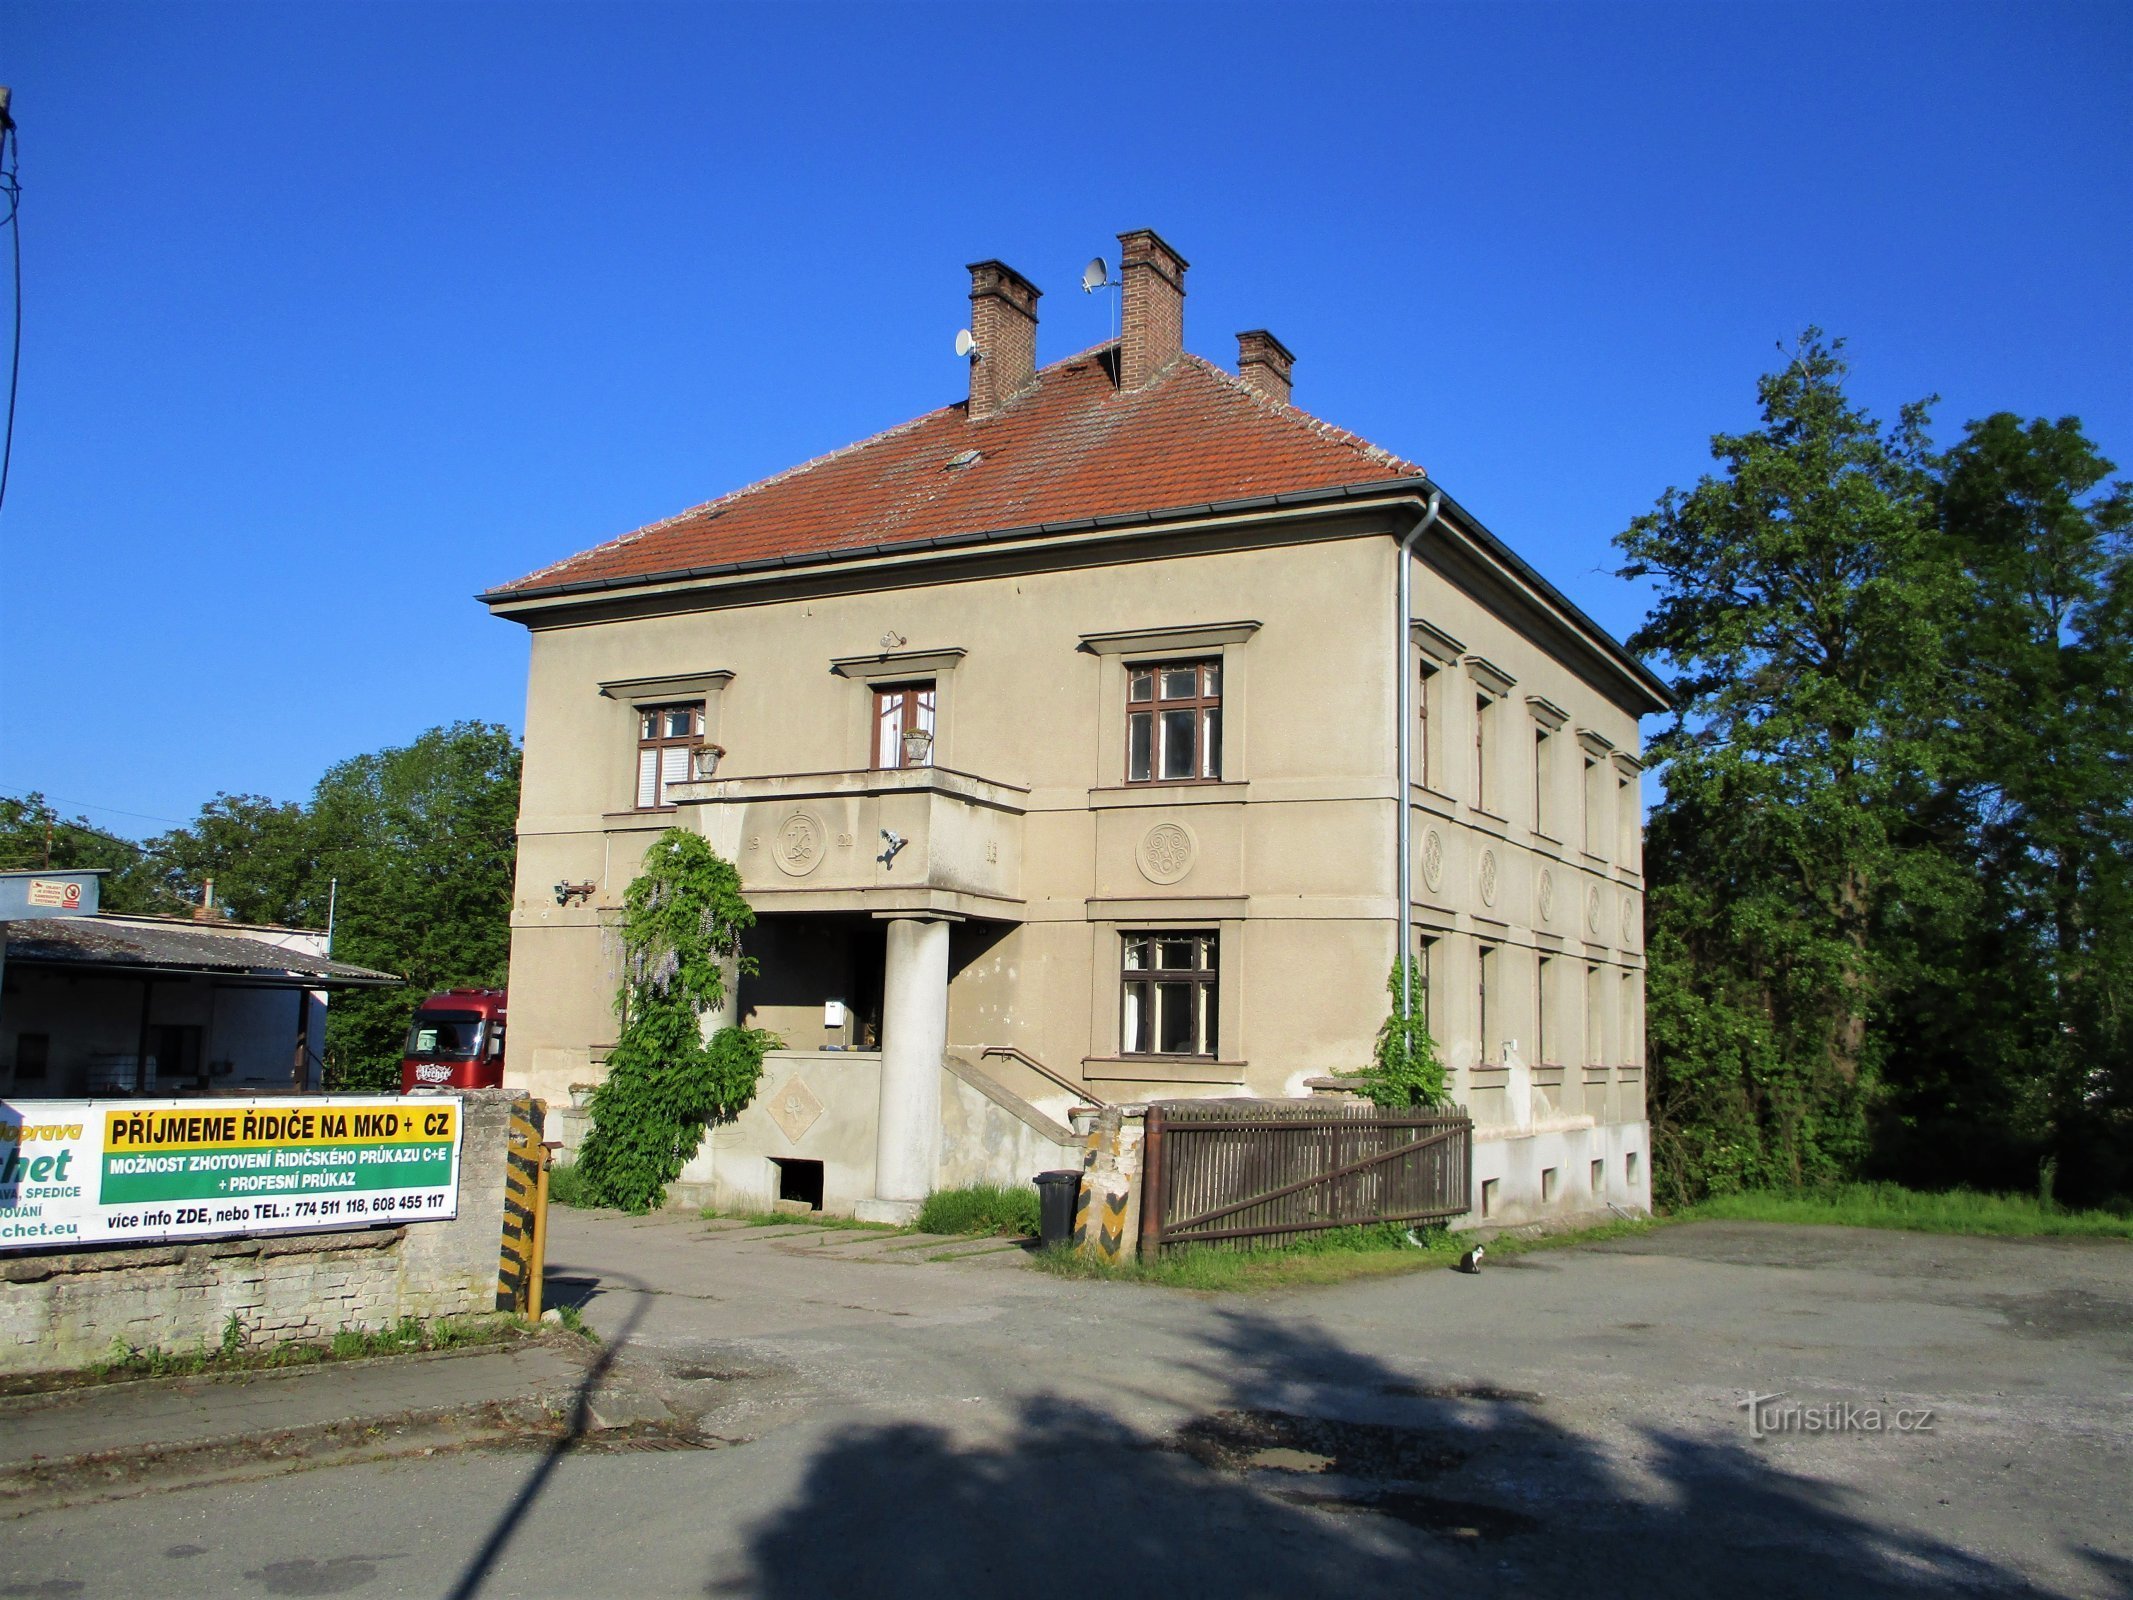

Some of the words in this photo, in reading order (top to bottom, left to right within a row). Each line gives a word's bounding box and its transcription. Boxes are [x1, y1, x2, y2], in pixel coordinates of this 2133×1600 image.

[112, 1112, 236, 1144] PŘÍJMEME
[242, 1109, 315, 1140] ŘIDIČE
[321, 1115, 348, 1138] NA
[354, 1113, 398, 1137] MKD
[404, 1117, 413, 1132] +
[424, 1113, 449, 1136] CZ
[0, 1148, 73, 1183] het
[110, 1154, 186, 1174] MOŽNOST
[189, 1150, 272, 1171] ZHOTOVENÍ
[275, 1148, 356, 1168] ŘIDIČSKÉHO
[359, 1145, 420, 1164] PRŮKAZU
[423, 1147, 447, 1162] C+E
[26, 1186, 81, 1199] SPEDICE
[218, 1180, 227, 1190] +
[230, 1171, 299, 1192] PROFESNÍ
[301, 1168, 356, 1188] PRŮKAZ
[108, 1213, 139, 1229] více
[143, 1210, 171, 1227] info
[176, 1208, 212, 1225] ZDE,
[216, 1206, 249, 1222] nebo
[254, 1204, 290, 1219] TEL.:
[295, 1201, 317, 1216] 774
[320, 1200, 341, 1215] 511
[346, 1199, 368, 1215] 118,
[372, 1197, 395, 1212] 608
[399, 1195, 422, 1209] 455
[427, 1194, 445, 1208] 117
